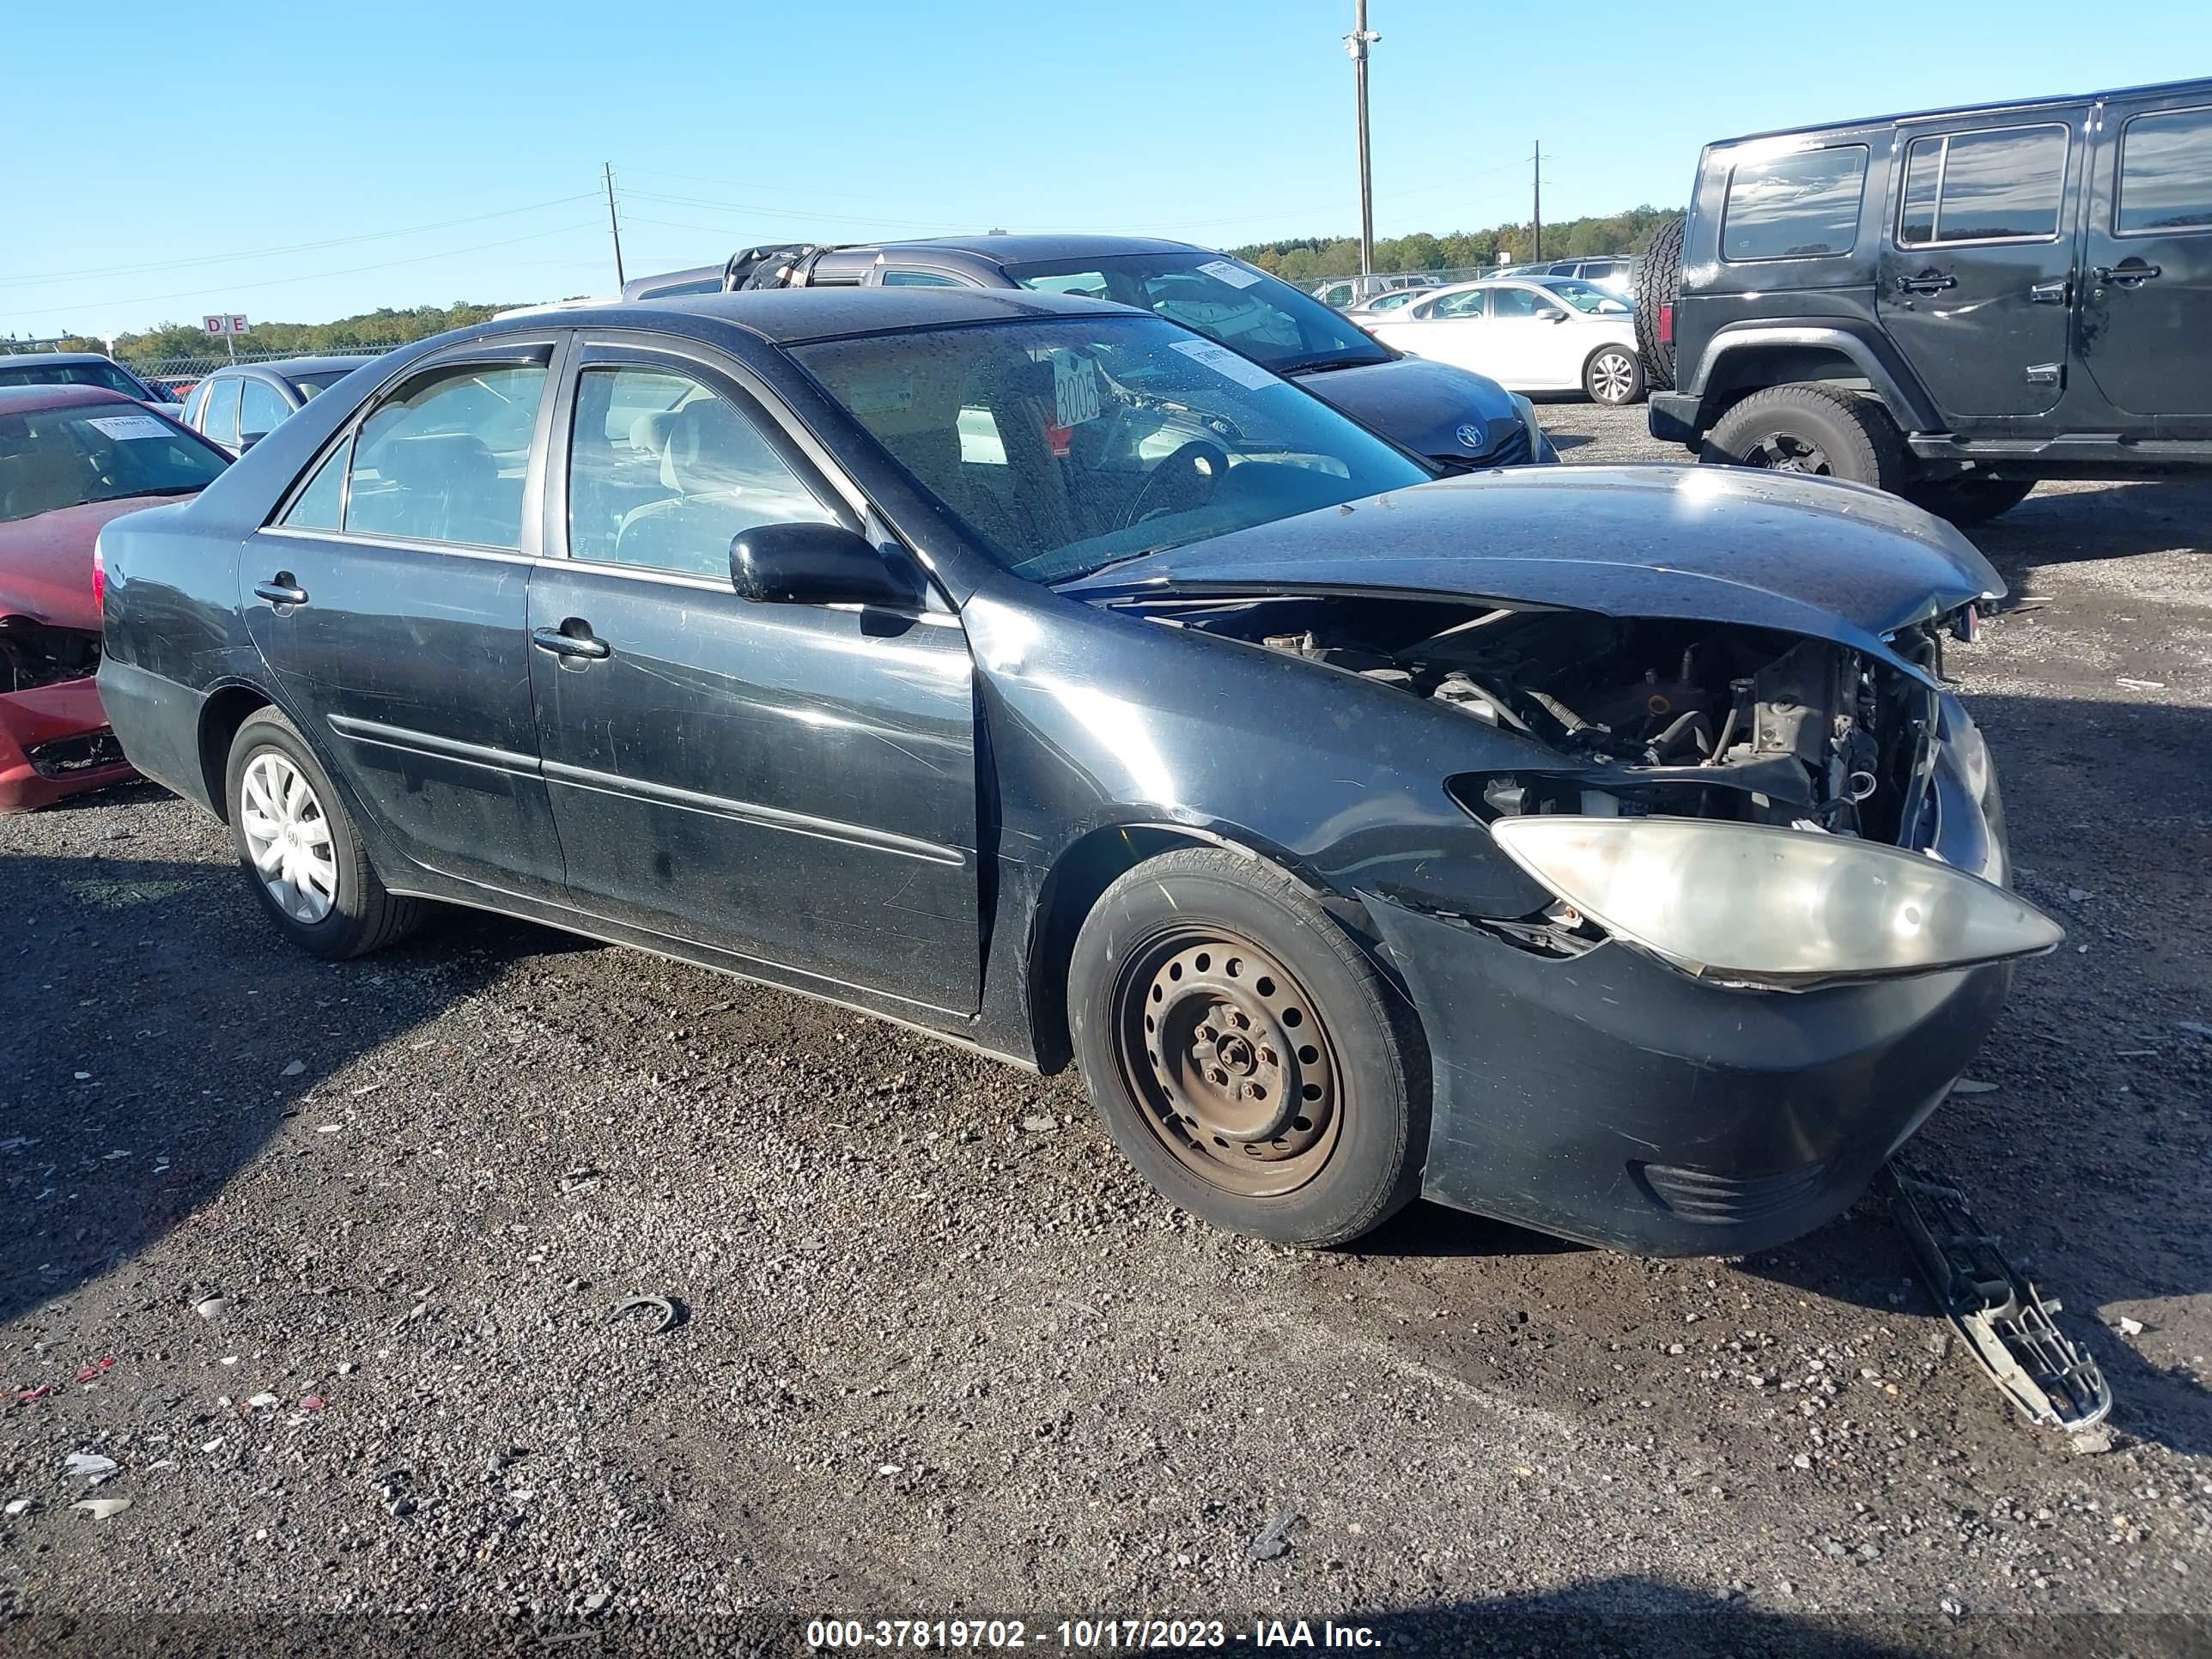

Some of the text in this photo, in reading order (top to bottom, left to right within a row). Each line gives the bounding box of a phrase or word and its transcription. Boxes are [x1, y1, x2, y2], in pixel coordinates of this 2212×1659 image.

[208, 319, 221, 332] D
[233, 318, 245, 331] E
[1056, 371, 1099, 426] 3005
